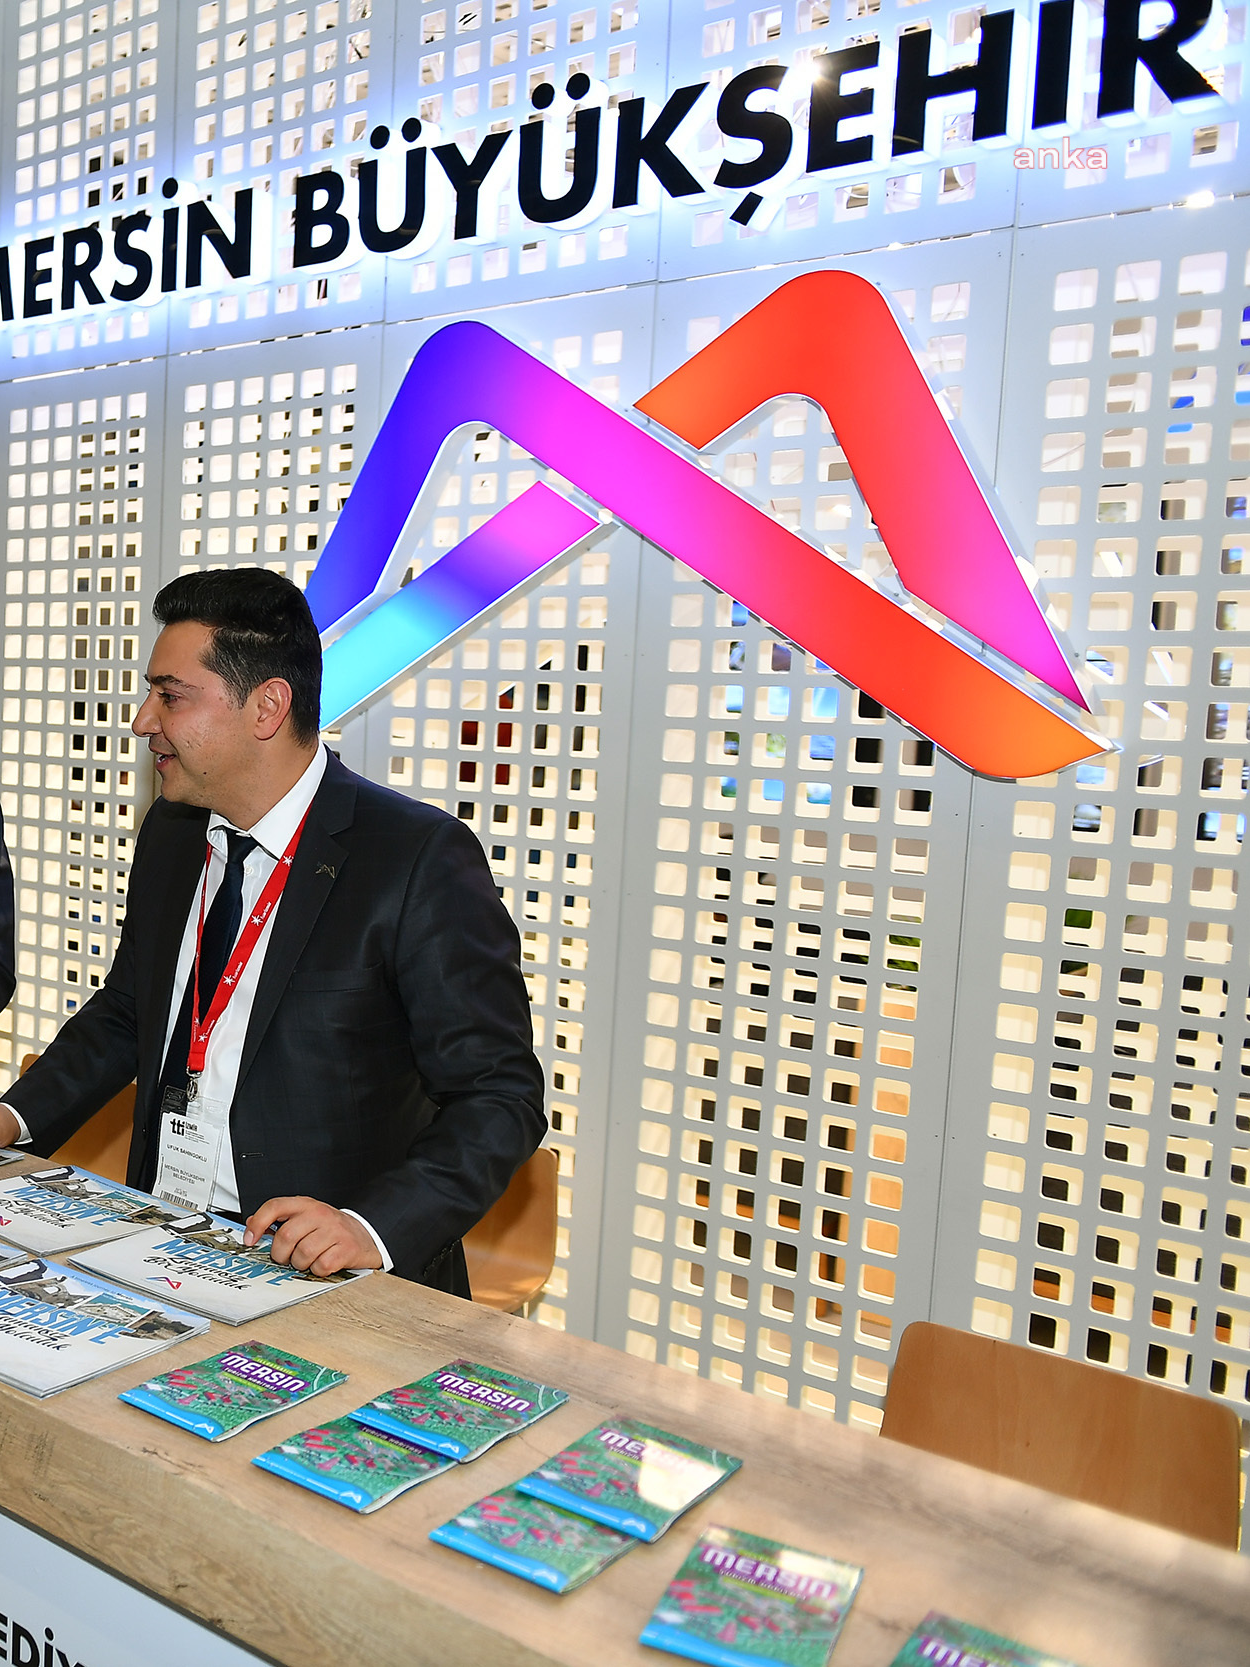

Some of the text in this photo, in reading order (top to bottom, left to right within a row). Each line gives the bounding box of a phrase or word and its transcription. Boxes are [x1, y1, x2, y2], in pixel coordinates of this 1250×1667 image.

[170, 1118, 185, 1136] tti
[221, 1354, 305, 1392] MERSIN
[436, 1374, 531, 1411] MERSIN
[703, 1548, 833, 1599] MERSIN
